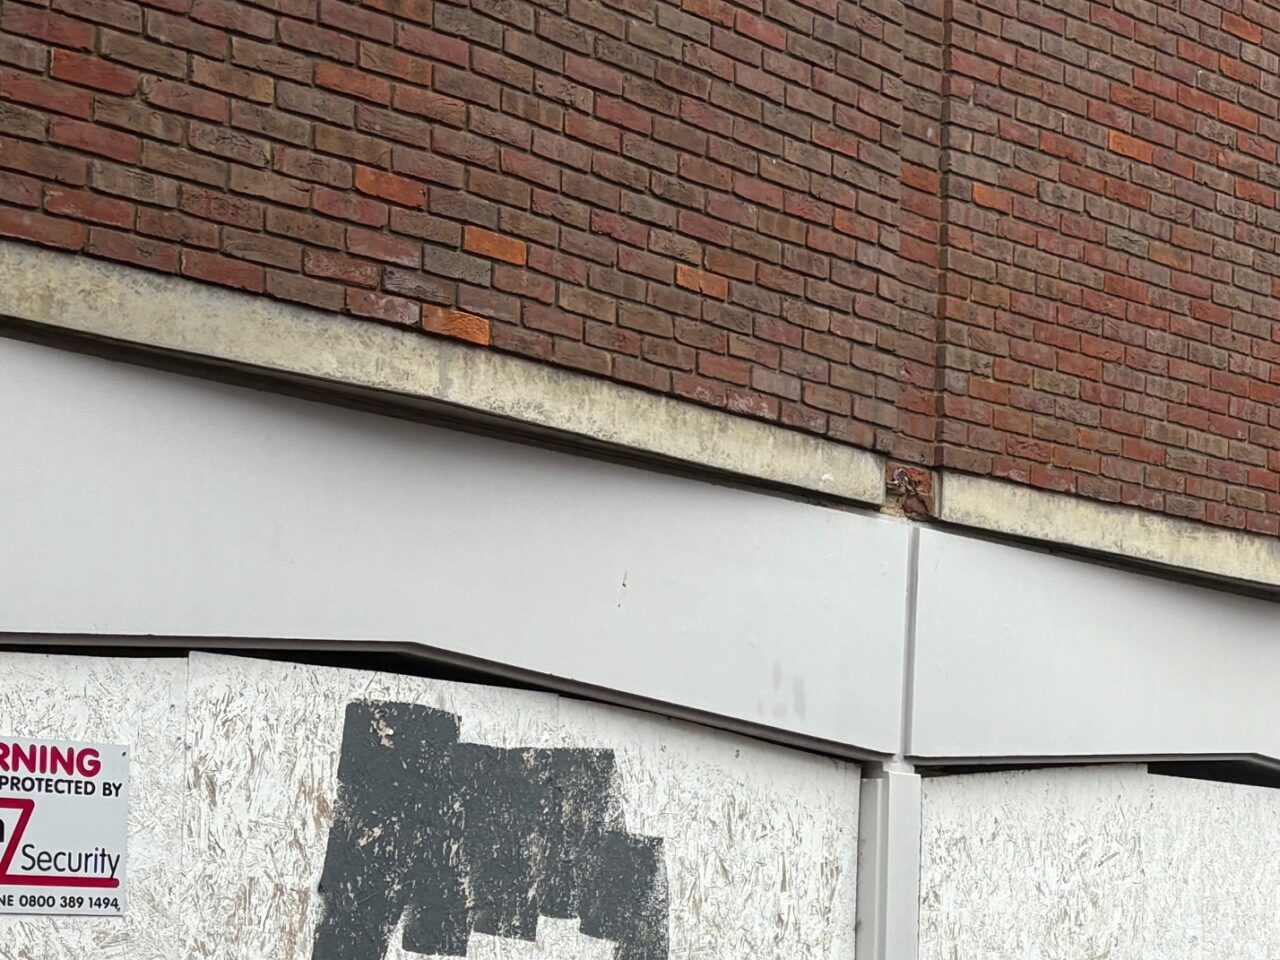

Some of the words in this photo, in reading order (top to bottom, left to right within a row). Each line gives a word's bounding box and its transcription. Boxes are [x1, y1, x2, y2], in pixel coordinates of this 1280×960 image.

[0, 775, 96, 795] PROTECTED
[102, 782, 123, 797] BY
[21, 843, 121, 879] Security
[19, 894, 56, 908] 0800
[60, 896, 84, 909] 389
[88, 897, 119, 909] 1494
